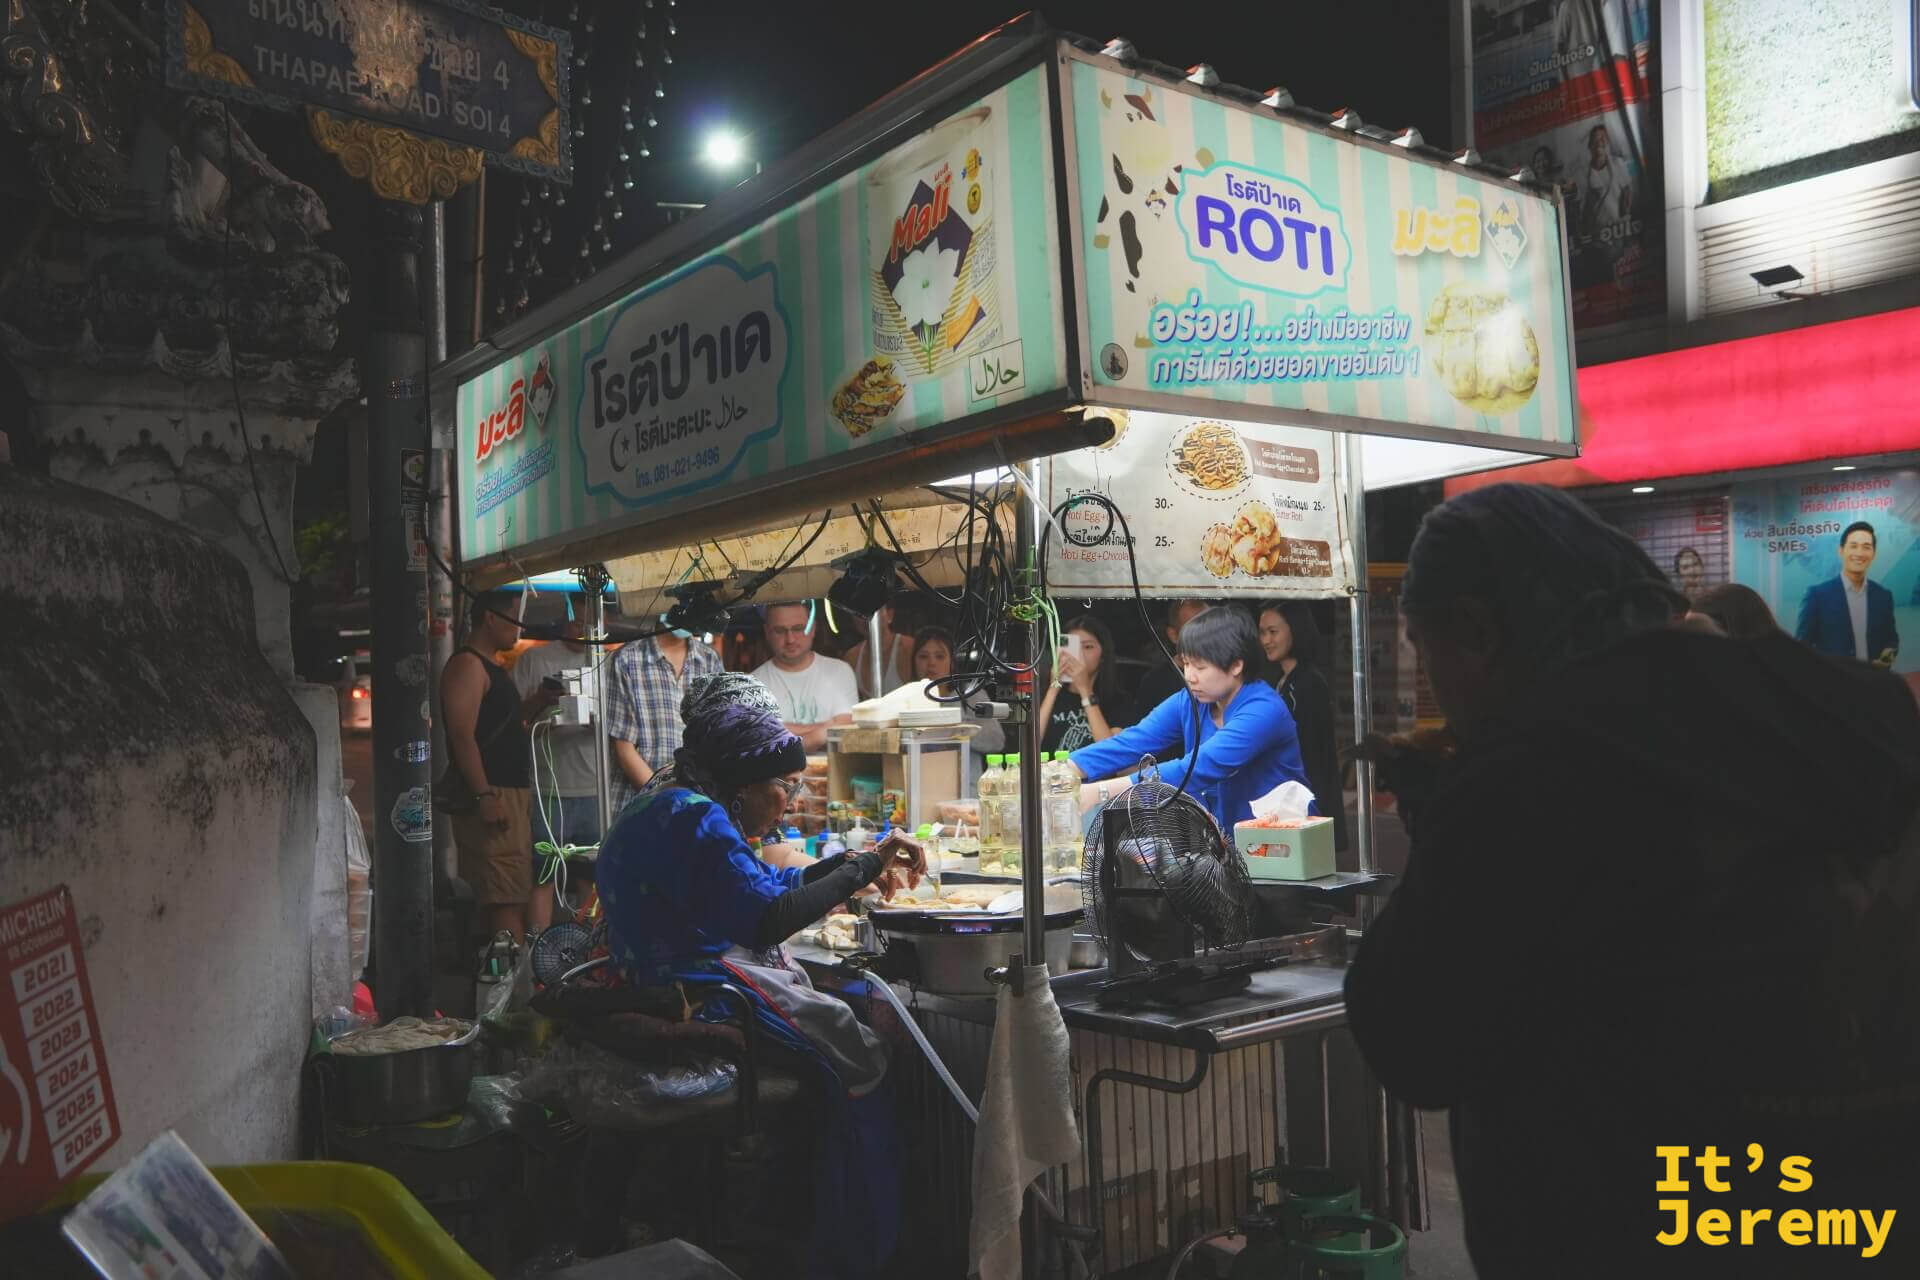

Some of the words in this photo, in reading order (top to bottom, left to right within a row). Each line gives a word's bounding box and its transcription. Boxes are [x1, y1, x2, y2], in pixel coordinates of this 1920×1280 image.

[253, 44, 362, 96] THAPAE
[370, 81, 440, 119] ROAD
[455, 101, 493, 133] SOI
[498, 114, 511, 138] 4
[494, 59, 510, 91] 4
[1225, 171, 1302, 215] โรตีป้าเด
[890, 172, 953, 264] Mali
[1195, 194, 1334, 276] ROTI
[1394, 197, 1479, 254] มะลิ
[590, 310, 772, 430] โรตีป้าเด
[975, 356, 1019, 397] حلال
[476, 379, 525, 461] มะลิ
[634, 410, 712, 455] โรตีมะตะบะ
[654, 447, 720, 480] 081-021-9496
[1154, 498, 1174, 510] 30.-
[1154, 535, 1175, 547] 25.-
[1767, 518, 1841, 539] สินเชื่อธุรกิจ
[1768, 540, 1807, 553] SMEs
[24, 952, 68, 992] 2021
[32, 988, 75, 1027] 2022
[40, 1020, 82, 1060] 2023
[48, 1054, 89, 1096] 2024
[56, 1086, 96, 1131] 2025
[64, 1119, 103, 1164] 2026
